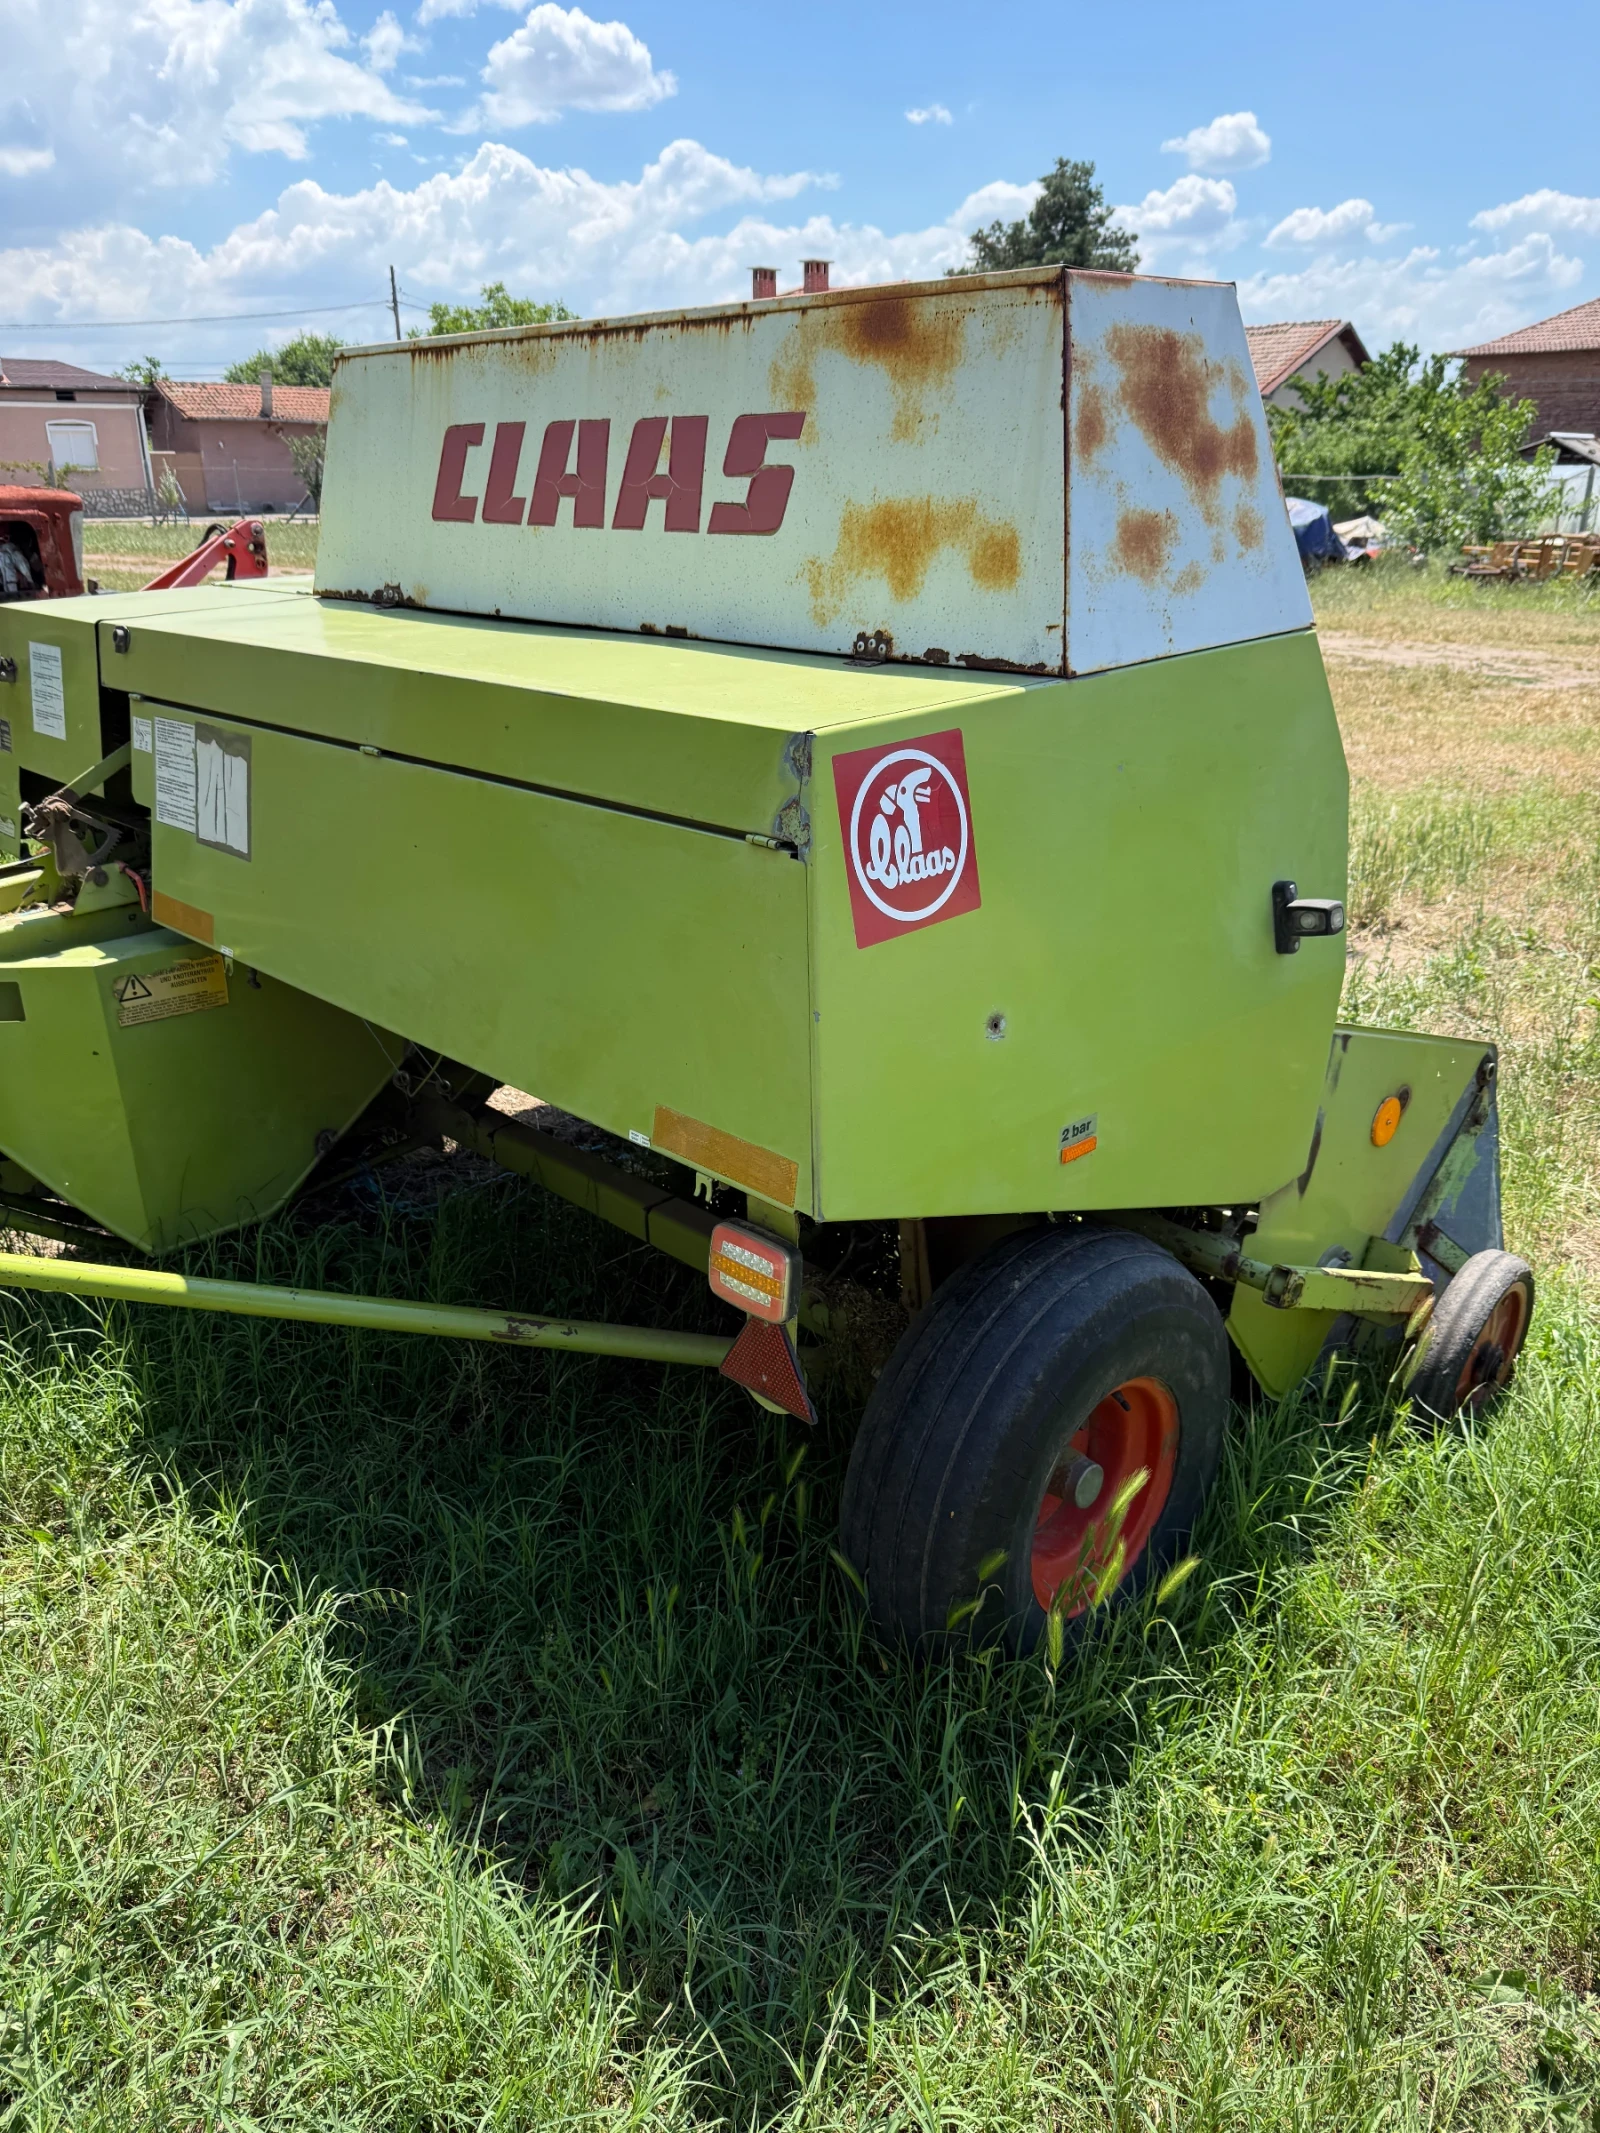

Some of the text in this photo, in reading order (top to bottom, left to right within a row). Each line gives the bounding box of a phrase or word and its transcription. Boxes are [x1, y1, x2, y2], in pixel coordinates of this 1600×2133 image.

[432, 411, 806, 536] CLAAS
[160, 975, 171, 983] UND
[171, 976, 207, 988] AUSSCHALTEN
[1061, 1120, 1092, 1143] 2 bar
